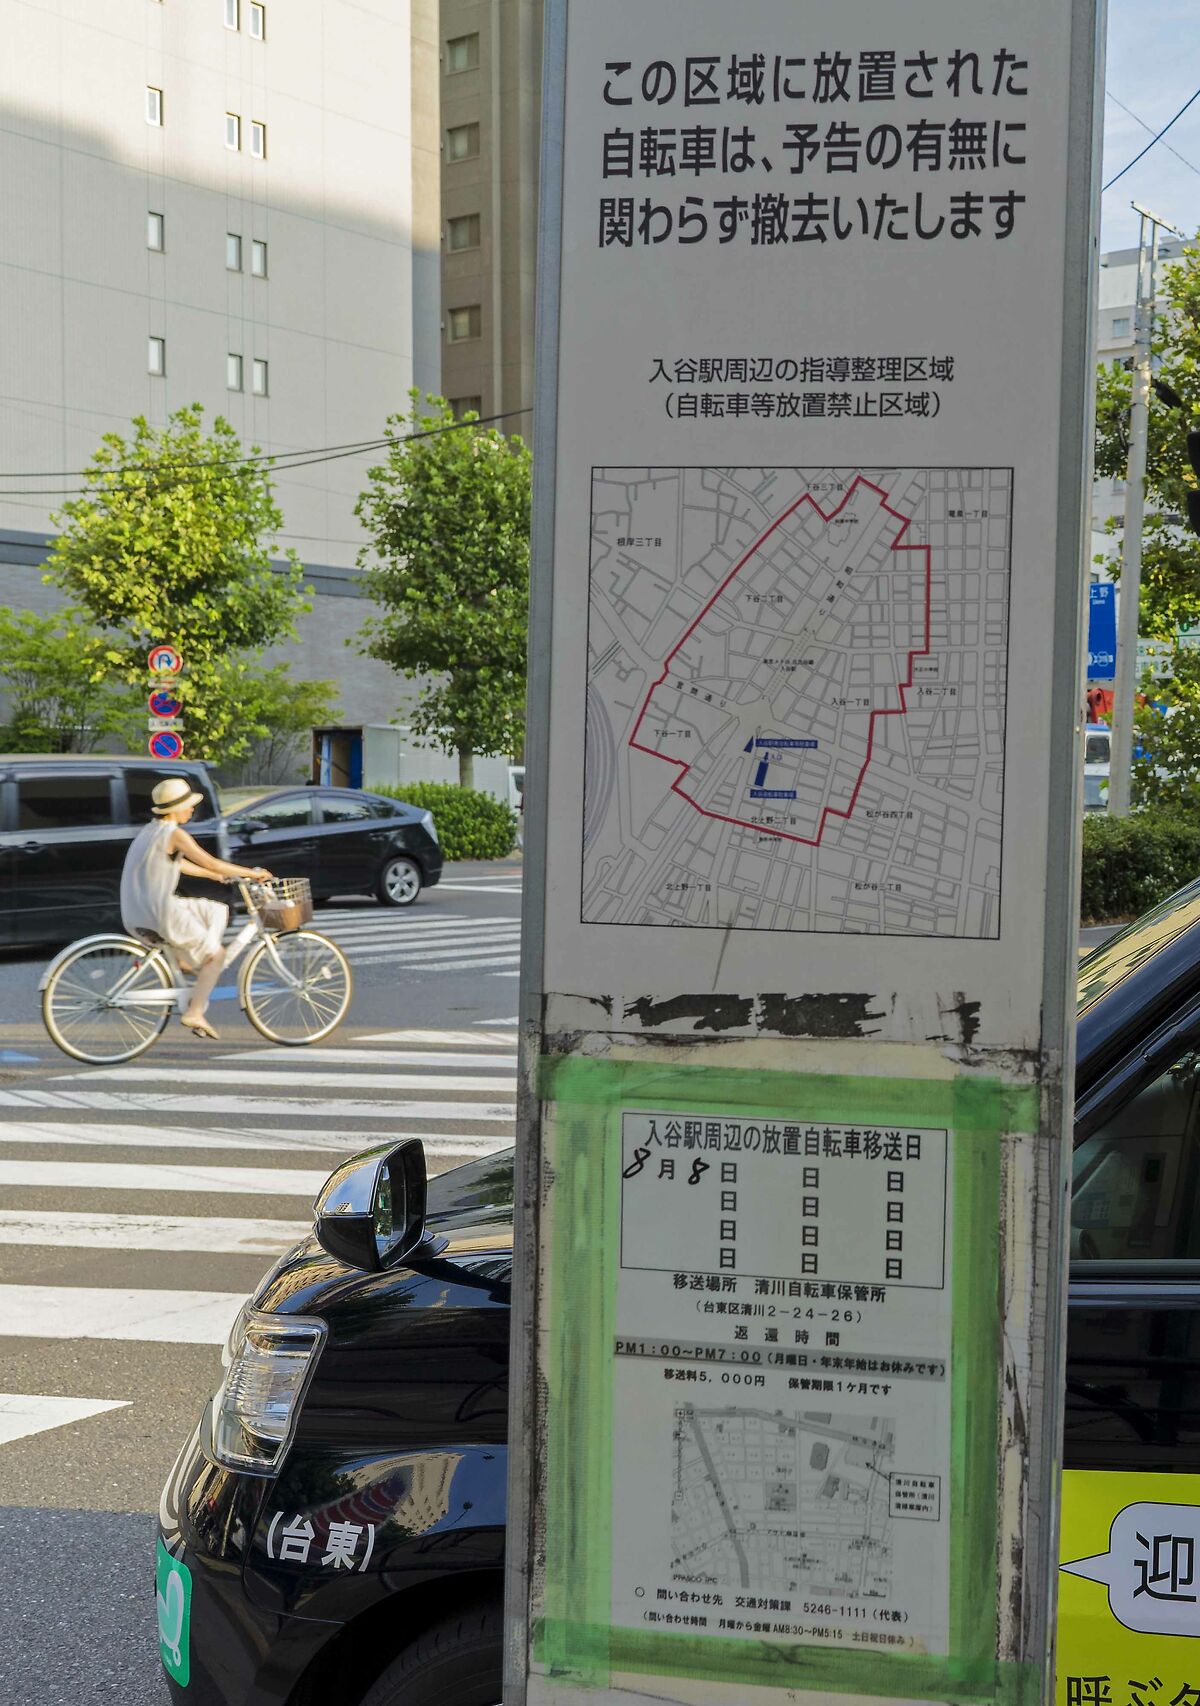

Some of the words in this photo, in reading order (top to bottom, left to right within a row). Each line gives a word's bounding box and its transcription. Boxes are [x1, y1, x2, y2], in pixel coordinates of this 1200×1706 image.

[601, 48, 1029, 106] この区域に放置された
[602, 118, 1027, 179] 自転車は、予告の有無に
[598, 189, 1026, 248] 関わらず撤去いたします
[648, 355, 955, 384] 入谷駅周辺の指導整理区域
[663, 391, 943, 419] （自転車等放置禁止区域）
[644, 1119, 922, 1162] 入谷駅周辺の放置自転車移送日
[720, 1190, 737, 1213] 日
[802, 1196, 819, 1219] 日
[886, 1201, 904, 1224] 日
[719, 1219, 737, 1242] 日
[801, 1225, 819, 1247] 日
[885, 1230, 903, 1252] 日
[719, 1247, 736, 1270] 日
[801, 1253, 818, 1275] 日
[885, 1258, 903, 1280] 日
[673, 1272, 737, 1295] 移送場所
[754, 1277, 887, 1303] 清川自転車保管所
[656, 1588, 723, 1606] 問い合わせ先
[735, 1596, 792, 1612] 交通対策課
